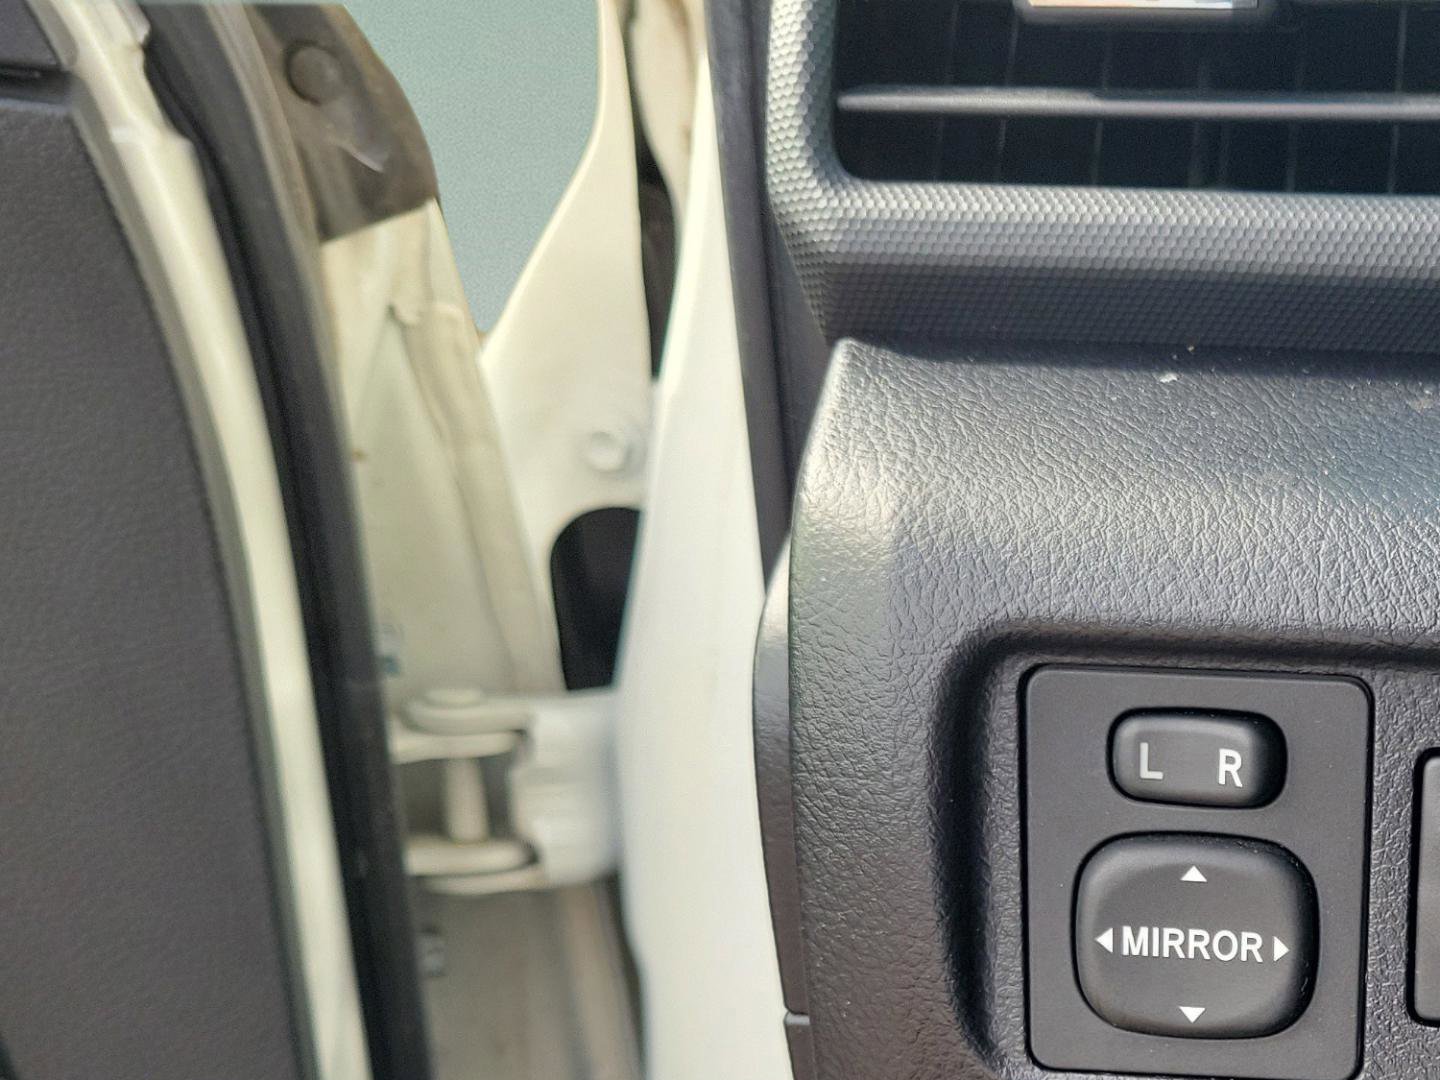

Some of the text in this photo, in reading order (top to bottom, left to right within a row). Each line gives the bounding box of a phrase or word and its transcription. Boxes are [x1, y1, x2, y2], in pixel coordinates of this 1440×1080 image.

[1139, 742, 1243, 788] L R
[1120, 925, 1264, 963] MIRROR
